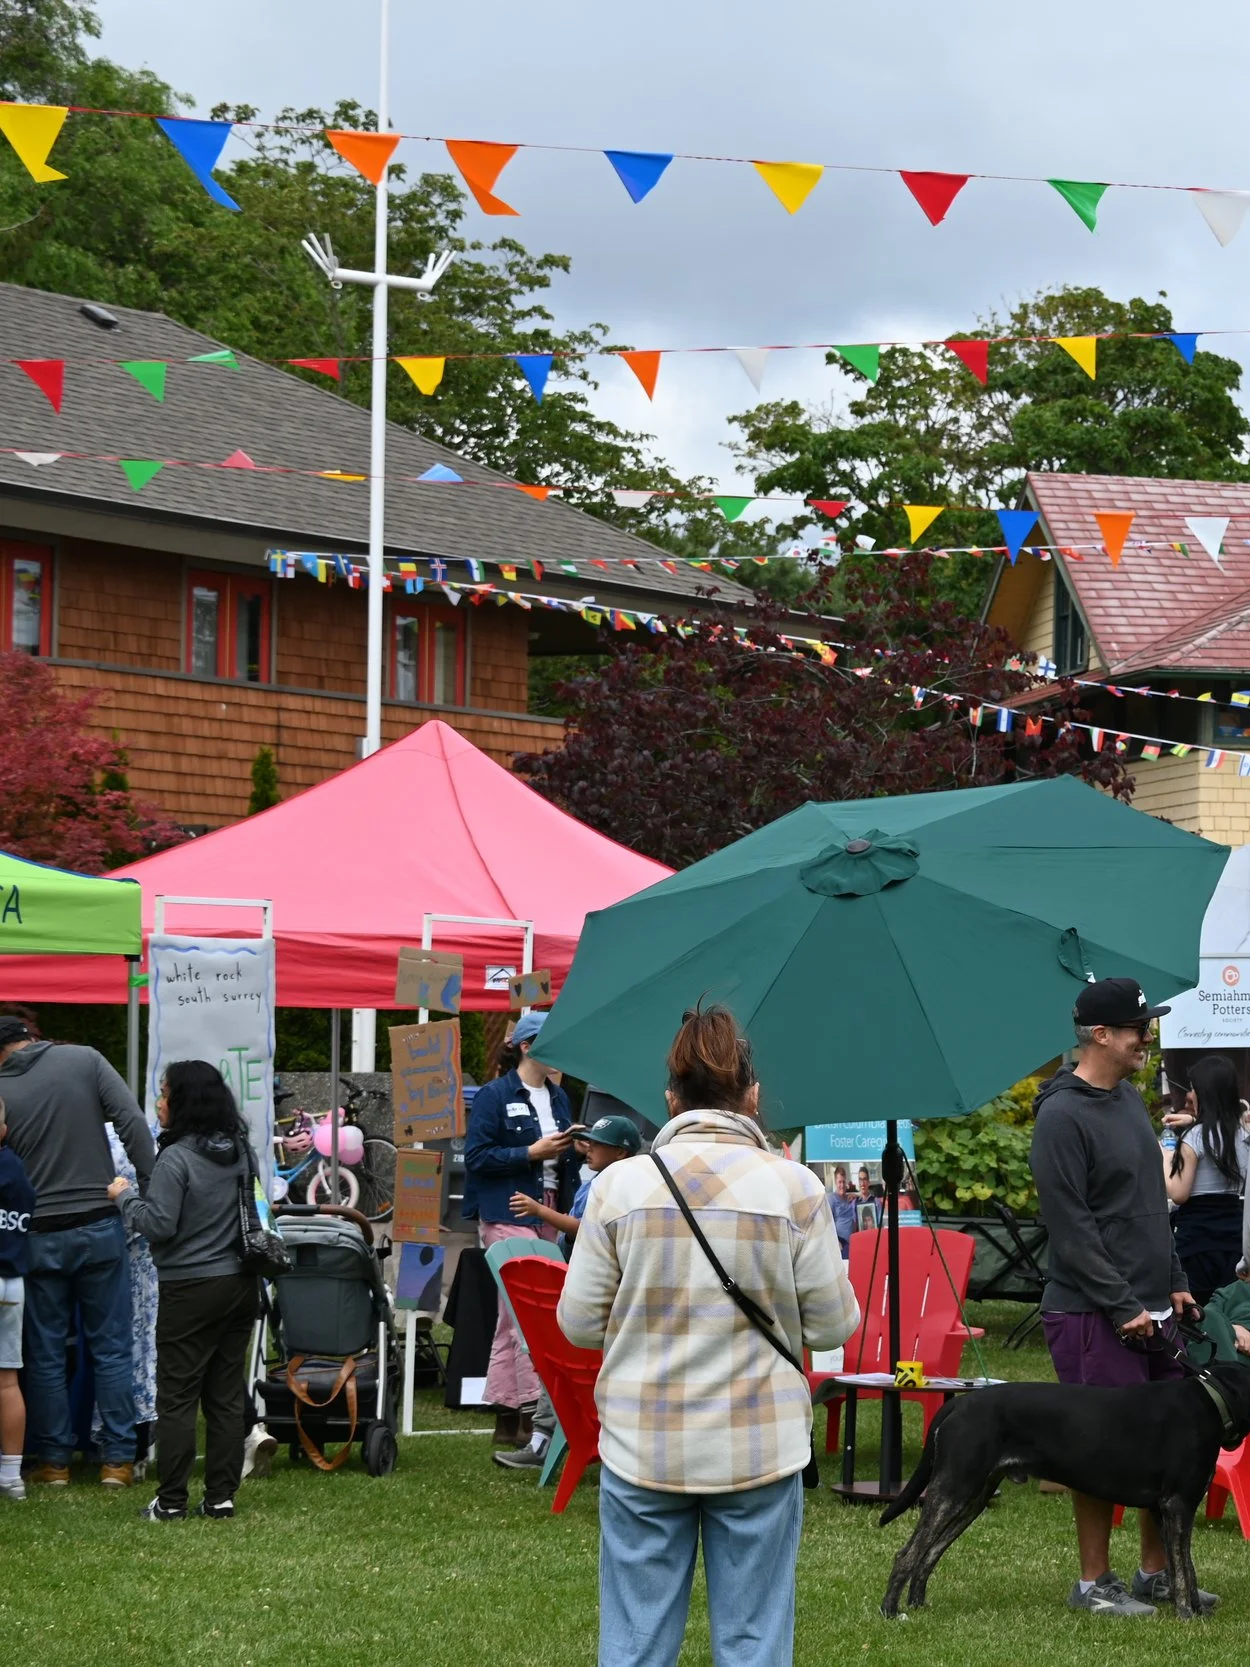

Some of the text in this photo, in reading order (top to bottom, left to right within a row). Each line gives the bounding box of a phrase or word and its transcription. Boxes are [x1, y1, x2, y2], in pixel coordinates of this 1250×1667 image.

[0, 884, 23, 924] A
[166, 961, 243, 983] white rock
[178, 986, 262, 1014] south surrey
[830, 1134, 853, 1148] Foster
